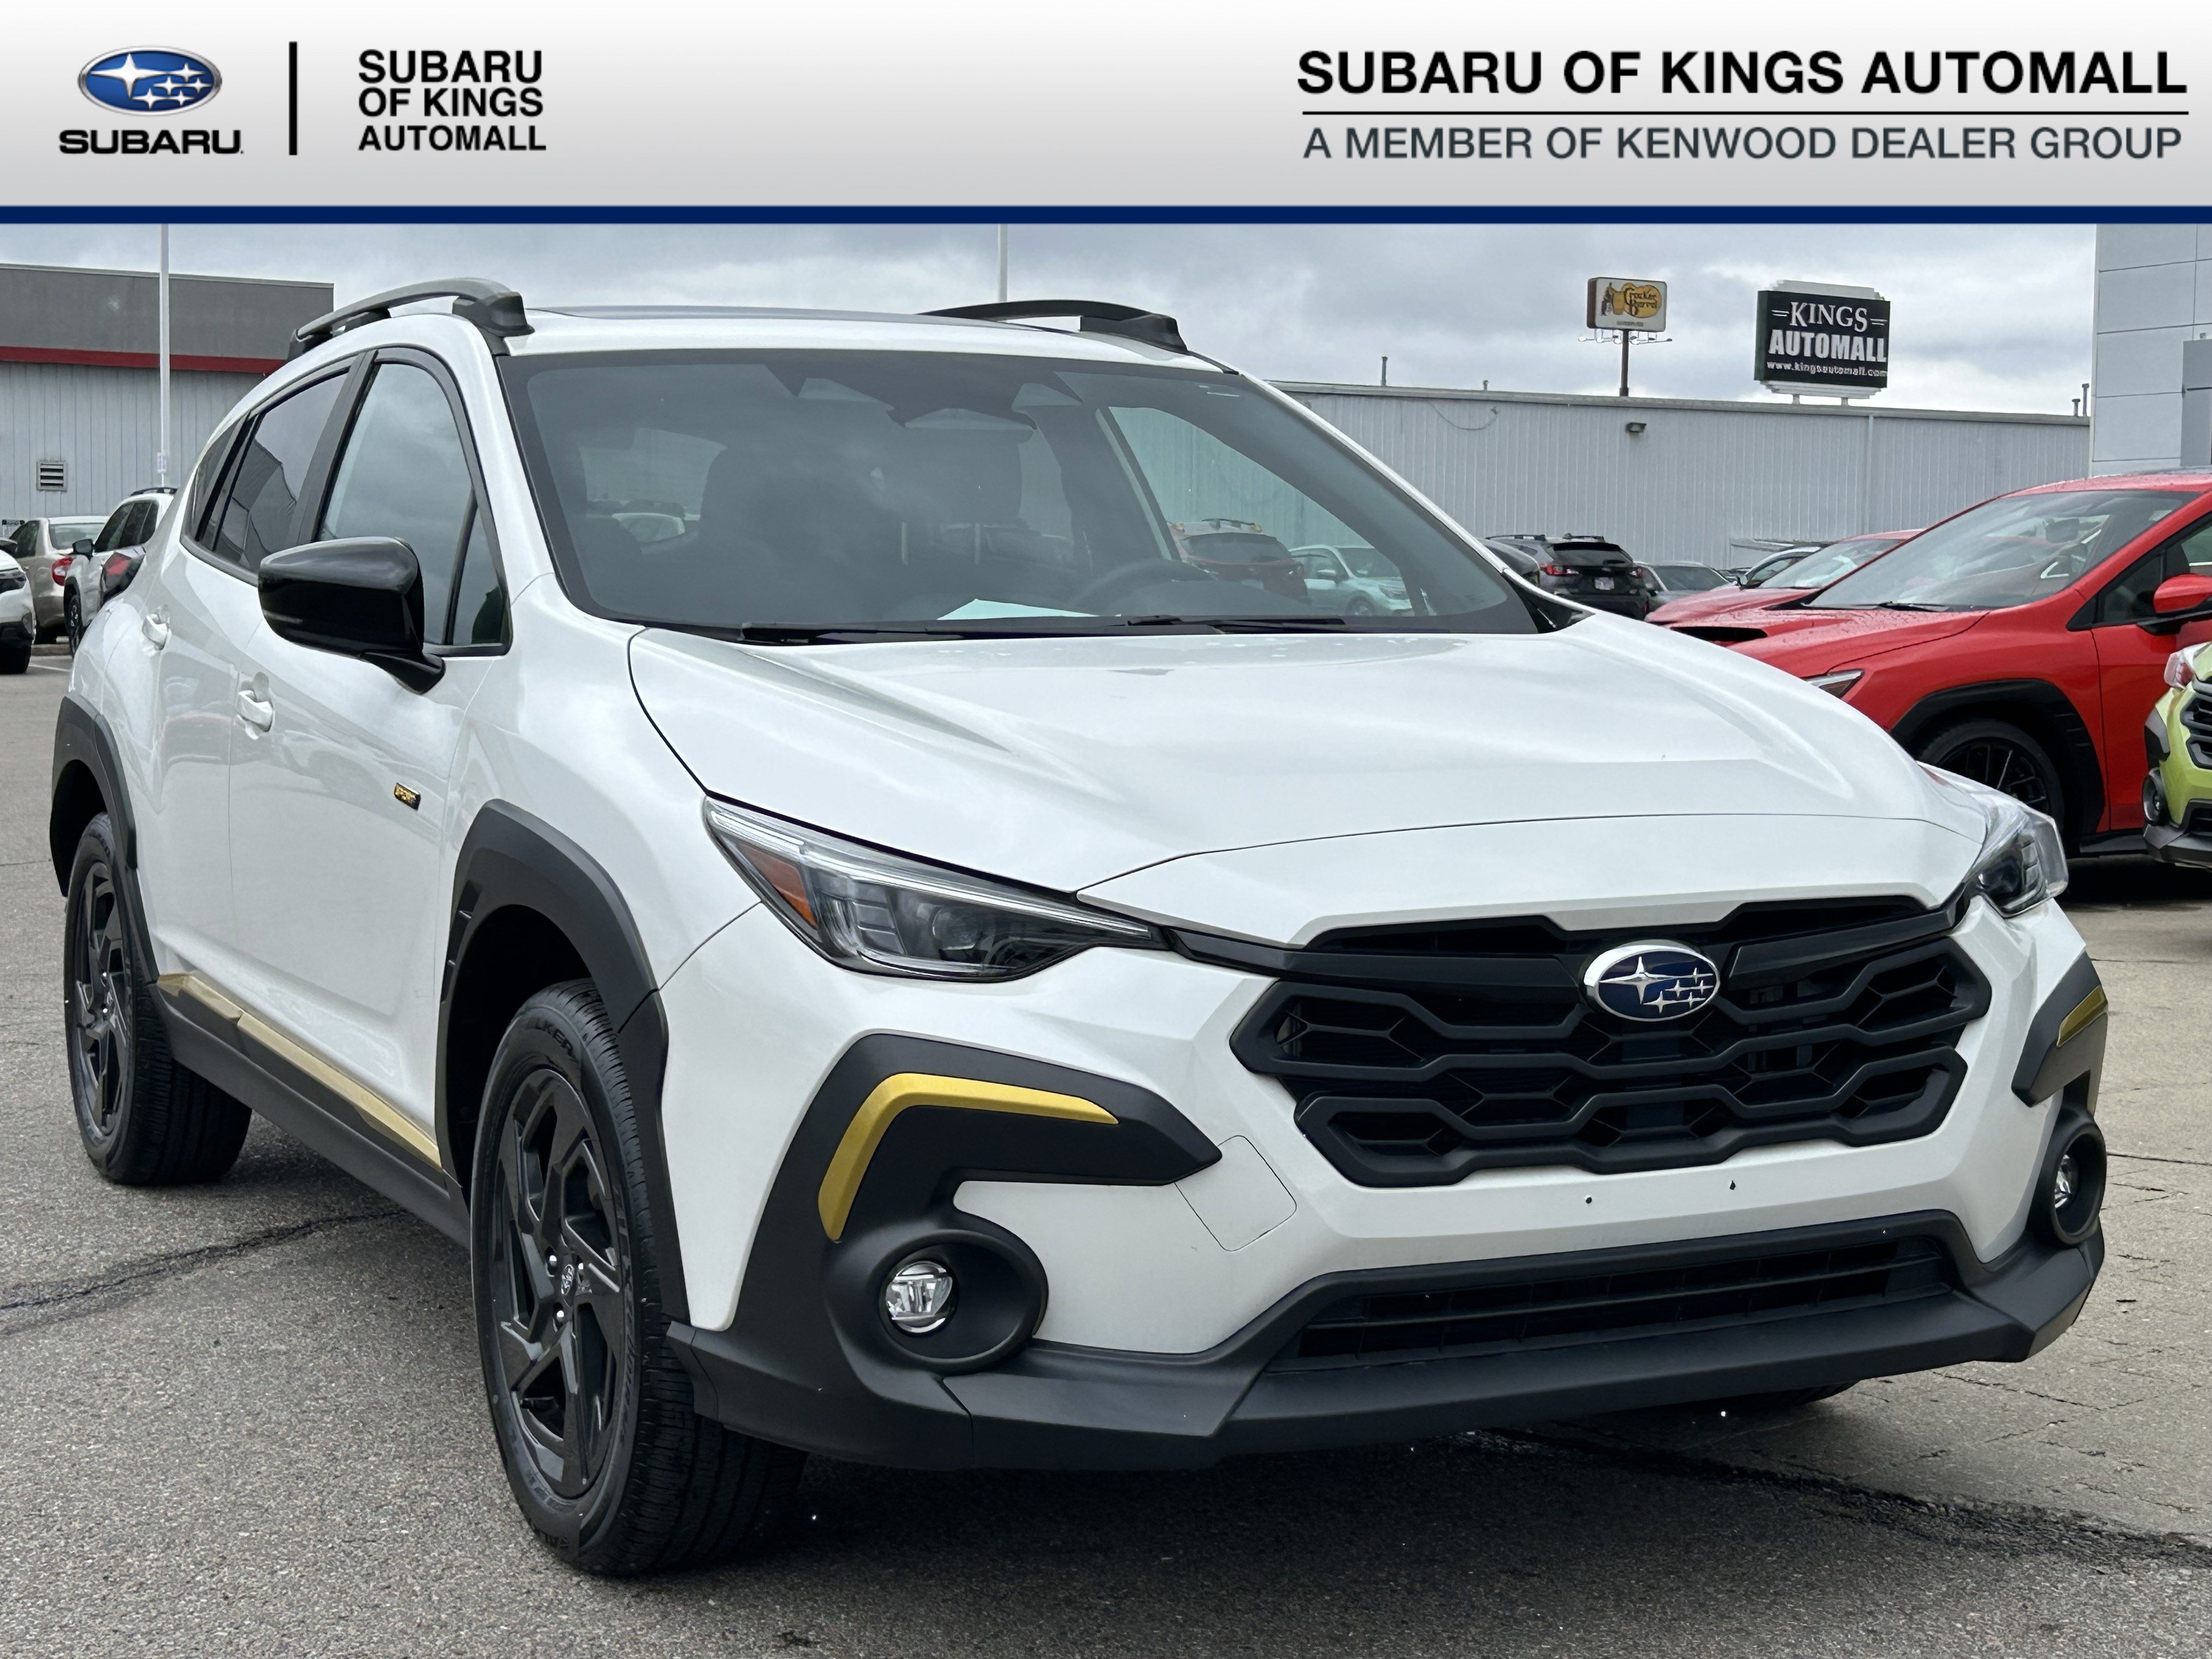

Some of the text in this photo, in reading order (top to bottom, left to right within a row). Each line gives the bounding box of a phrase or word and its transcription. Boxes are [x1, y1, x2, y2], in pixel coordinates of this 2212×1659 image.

[1789, 302, 1868, 332] KINGS
[1768, 329, 1887, 362] AUTOMALL
[1767, 361, 1887, 377] www.kingsautomall.com
